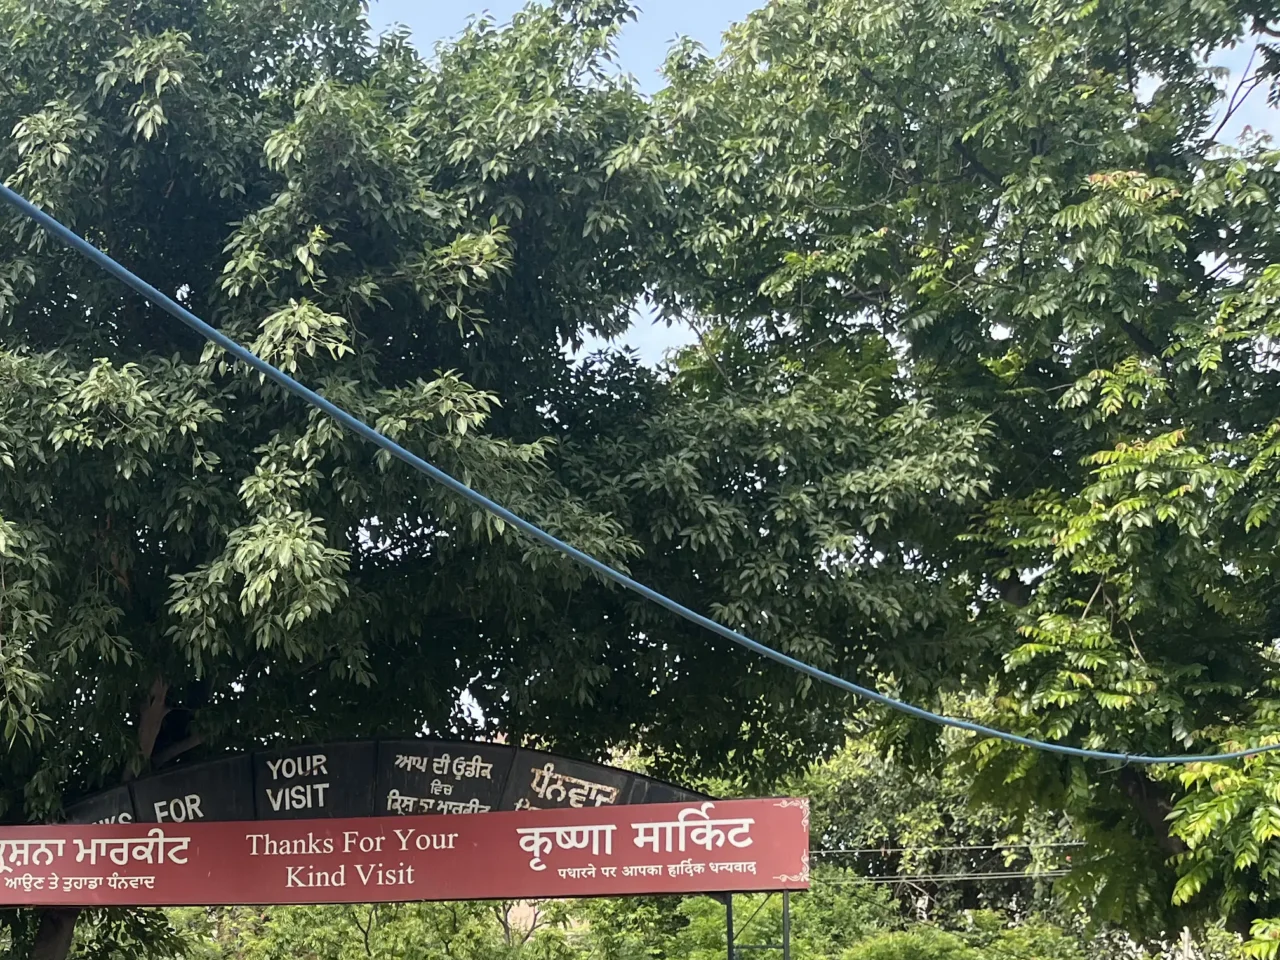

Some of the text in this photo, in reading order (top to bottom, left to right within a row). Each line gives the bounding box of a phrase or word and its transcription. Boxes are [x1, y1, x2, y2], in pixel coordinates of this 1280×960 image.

[266, 754, 328, 780] YOUR
[153, 794, 203, 823] FOR
[266, 783, 330, 811] VISIT
[73, 828, 191, 865] ਮਾਰਕੀਟ
[245, 828, 459, 856] Thanks For Your
[516, 802, 755, 871] कृष्णा मार्किट
[48, 872, 59, 890] ਤੇ
[107, 872, 155, 889] ਧੰਨਵਾਦ
[285, 862, 415, 888] Kind Visit
[557, 858, 757, 880] पधारने पर आपका हार्दिक धन्यवाद
